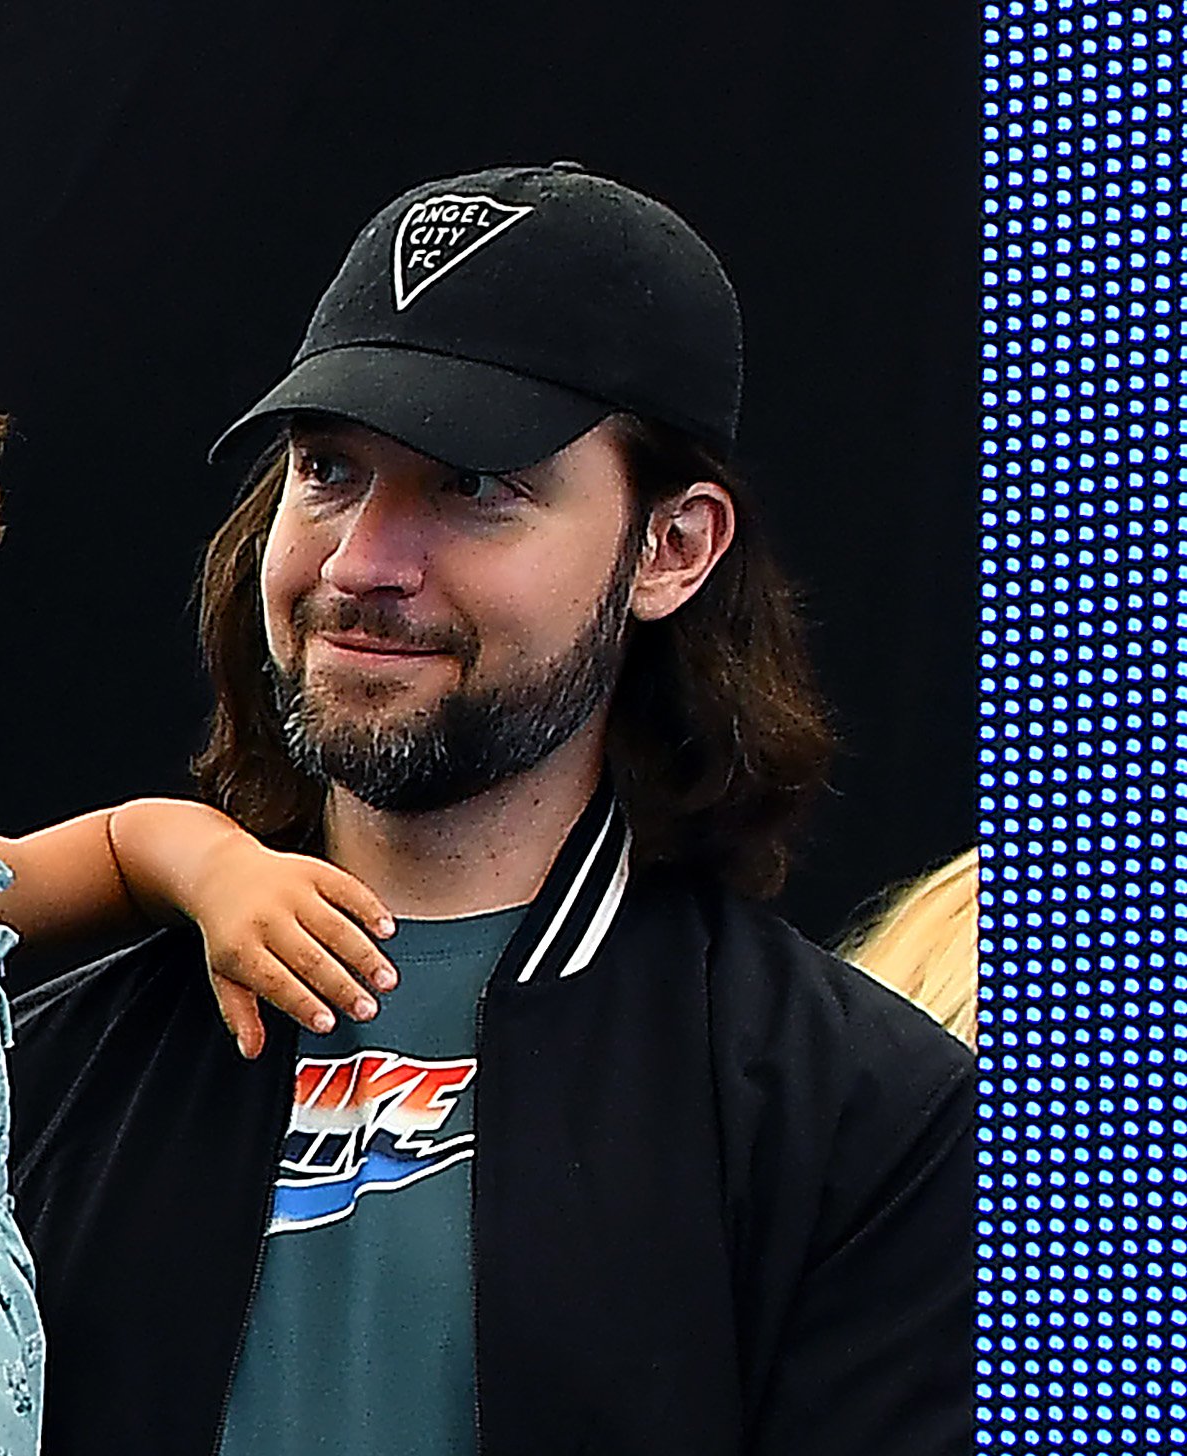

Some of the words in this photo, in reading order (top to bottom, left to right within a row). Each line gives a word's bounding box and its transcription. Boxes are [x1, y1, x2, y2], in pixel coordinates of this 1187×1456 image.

[411, 204, 490, 227] ANGEL
[409, 226, 466, 246] CITY
[407, 249, 441, 269] FC
